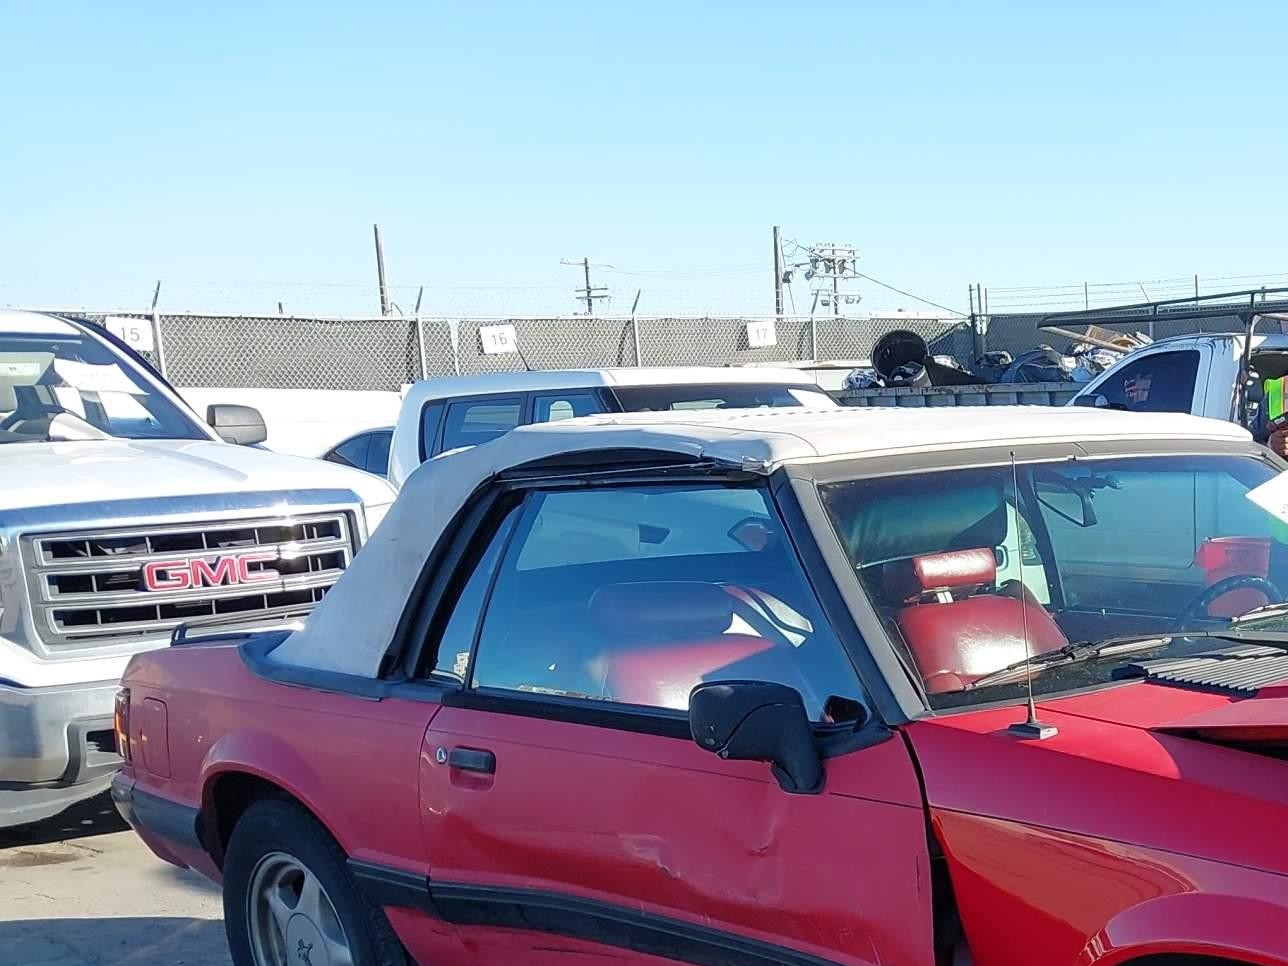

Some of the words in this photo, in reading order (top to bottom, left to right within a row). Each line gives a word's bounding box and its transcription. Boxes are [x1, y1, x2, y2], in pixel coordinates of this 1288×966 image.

[120, 326, 141, 343] 15
[490, 331, 508, 346] 16
[756, 327, 768, 340] 17
[144, 551, 280, 592] GMC
